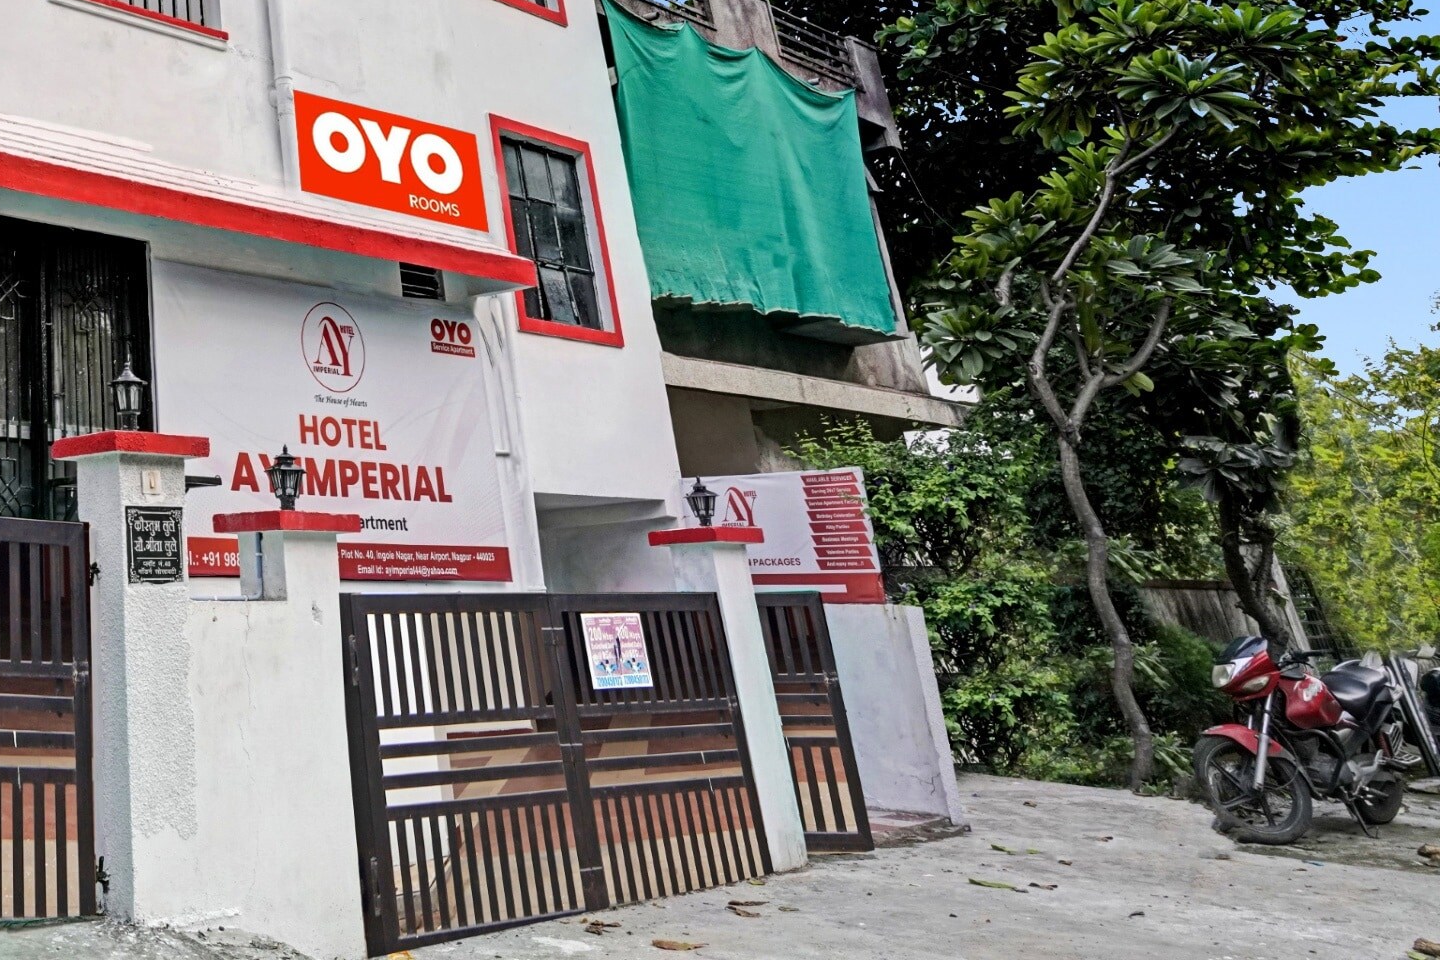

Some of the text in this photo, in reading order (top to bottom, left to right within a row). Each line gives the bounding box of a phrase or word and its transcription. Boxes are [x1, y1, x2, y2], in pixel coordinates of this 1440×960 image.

[312, 111, 463, 194] OYO
[409, 194, 460, 217] ROOMS
[340, 325, 355, 336] HOTEL
[431, 318, 471, 345] OYO
[432, 343, 474, 355] Service Apartment
[313, 365, 340, 376] IMPERIAL
[314, 394, 368, 408] The House of Hearts
[299, 414, 387, 451] HOTEL
[831, 474, 853, 482] SERVICES
[360, 515, 408, 531] artment
[202, 551, 221, 567] +91
[340, 549, 354, 559] Plot
[355, 549, 365, 559] No.
[376, 550, 394, 562] Ingole
[396, 551, 415, 562] Nagar,
[416, 551, 429, 560] Near
[451, 552, 472, 563] Nagpur
[753, 557, 801, 566] PACKAGES
[357, 564, 375, 574] Email
